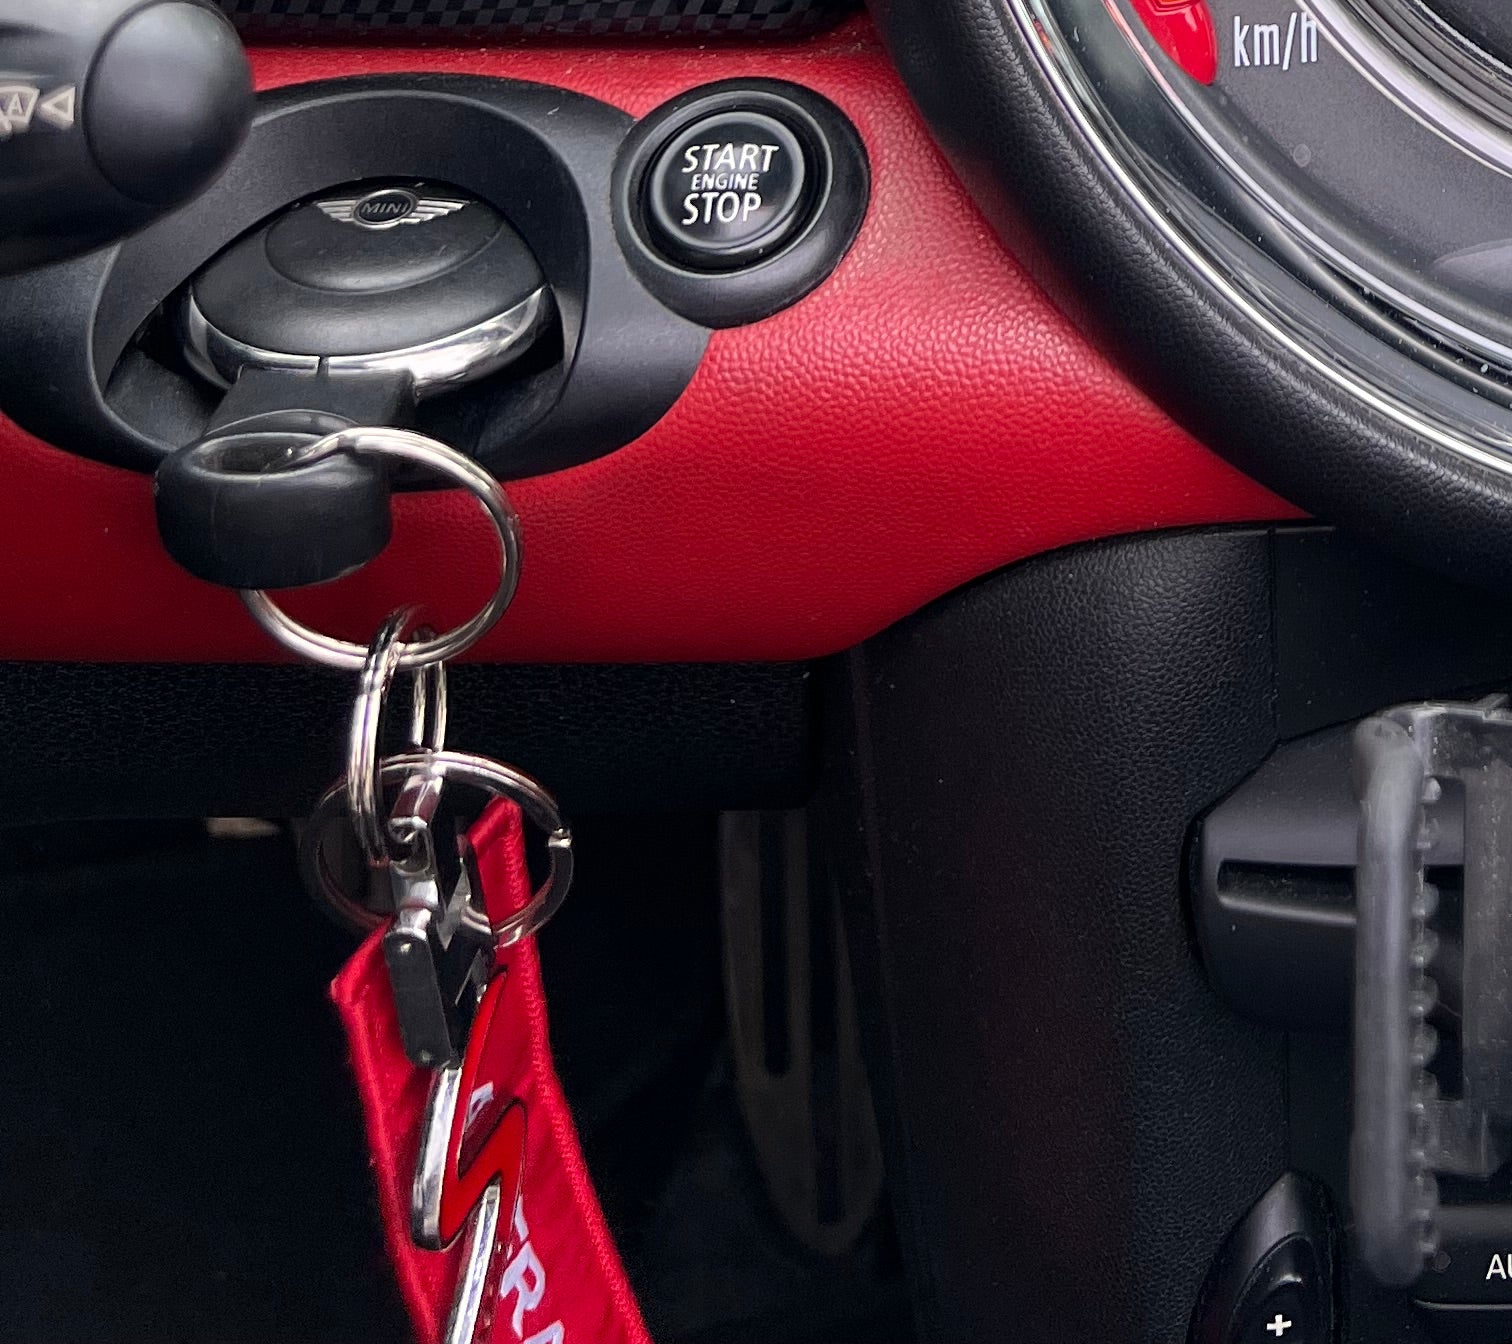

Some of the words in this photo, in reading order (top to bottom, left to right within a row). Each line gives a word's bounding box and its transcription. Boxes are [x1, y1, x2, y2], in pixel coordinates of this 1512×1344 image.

[1232, 12, 1319, 70] km/h
[682, 143, 780, 173] START
[691, 173, 760, 190] ENGINE
[361, 202, 409, 213] MINI
[682, 192, 762, 225] STOP
